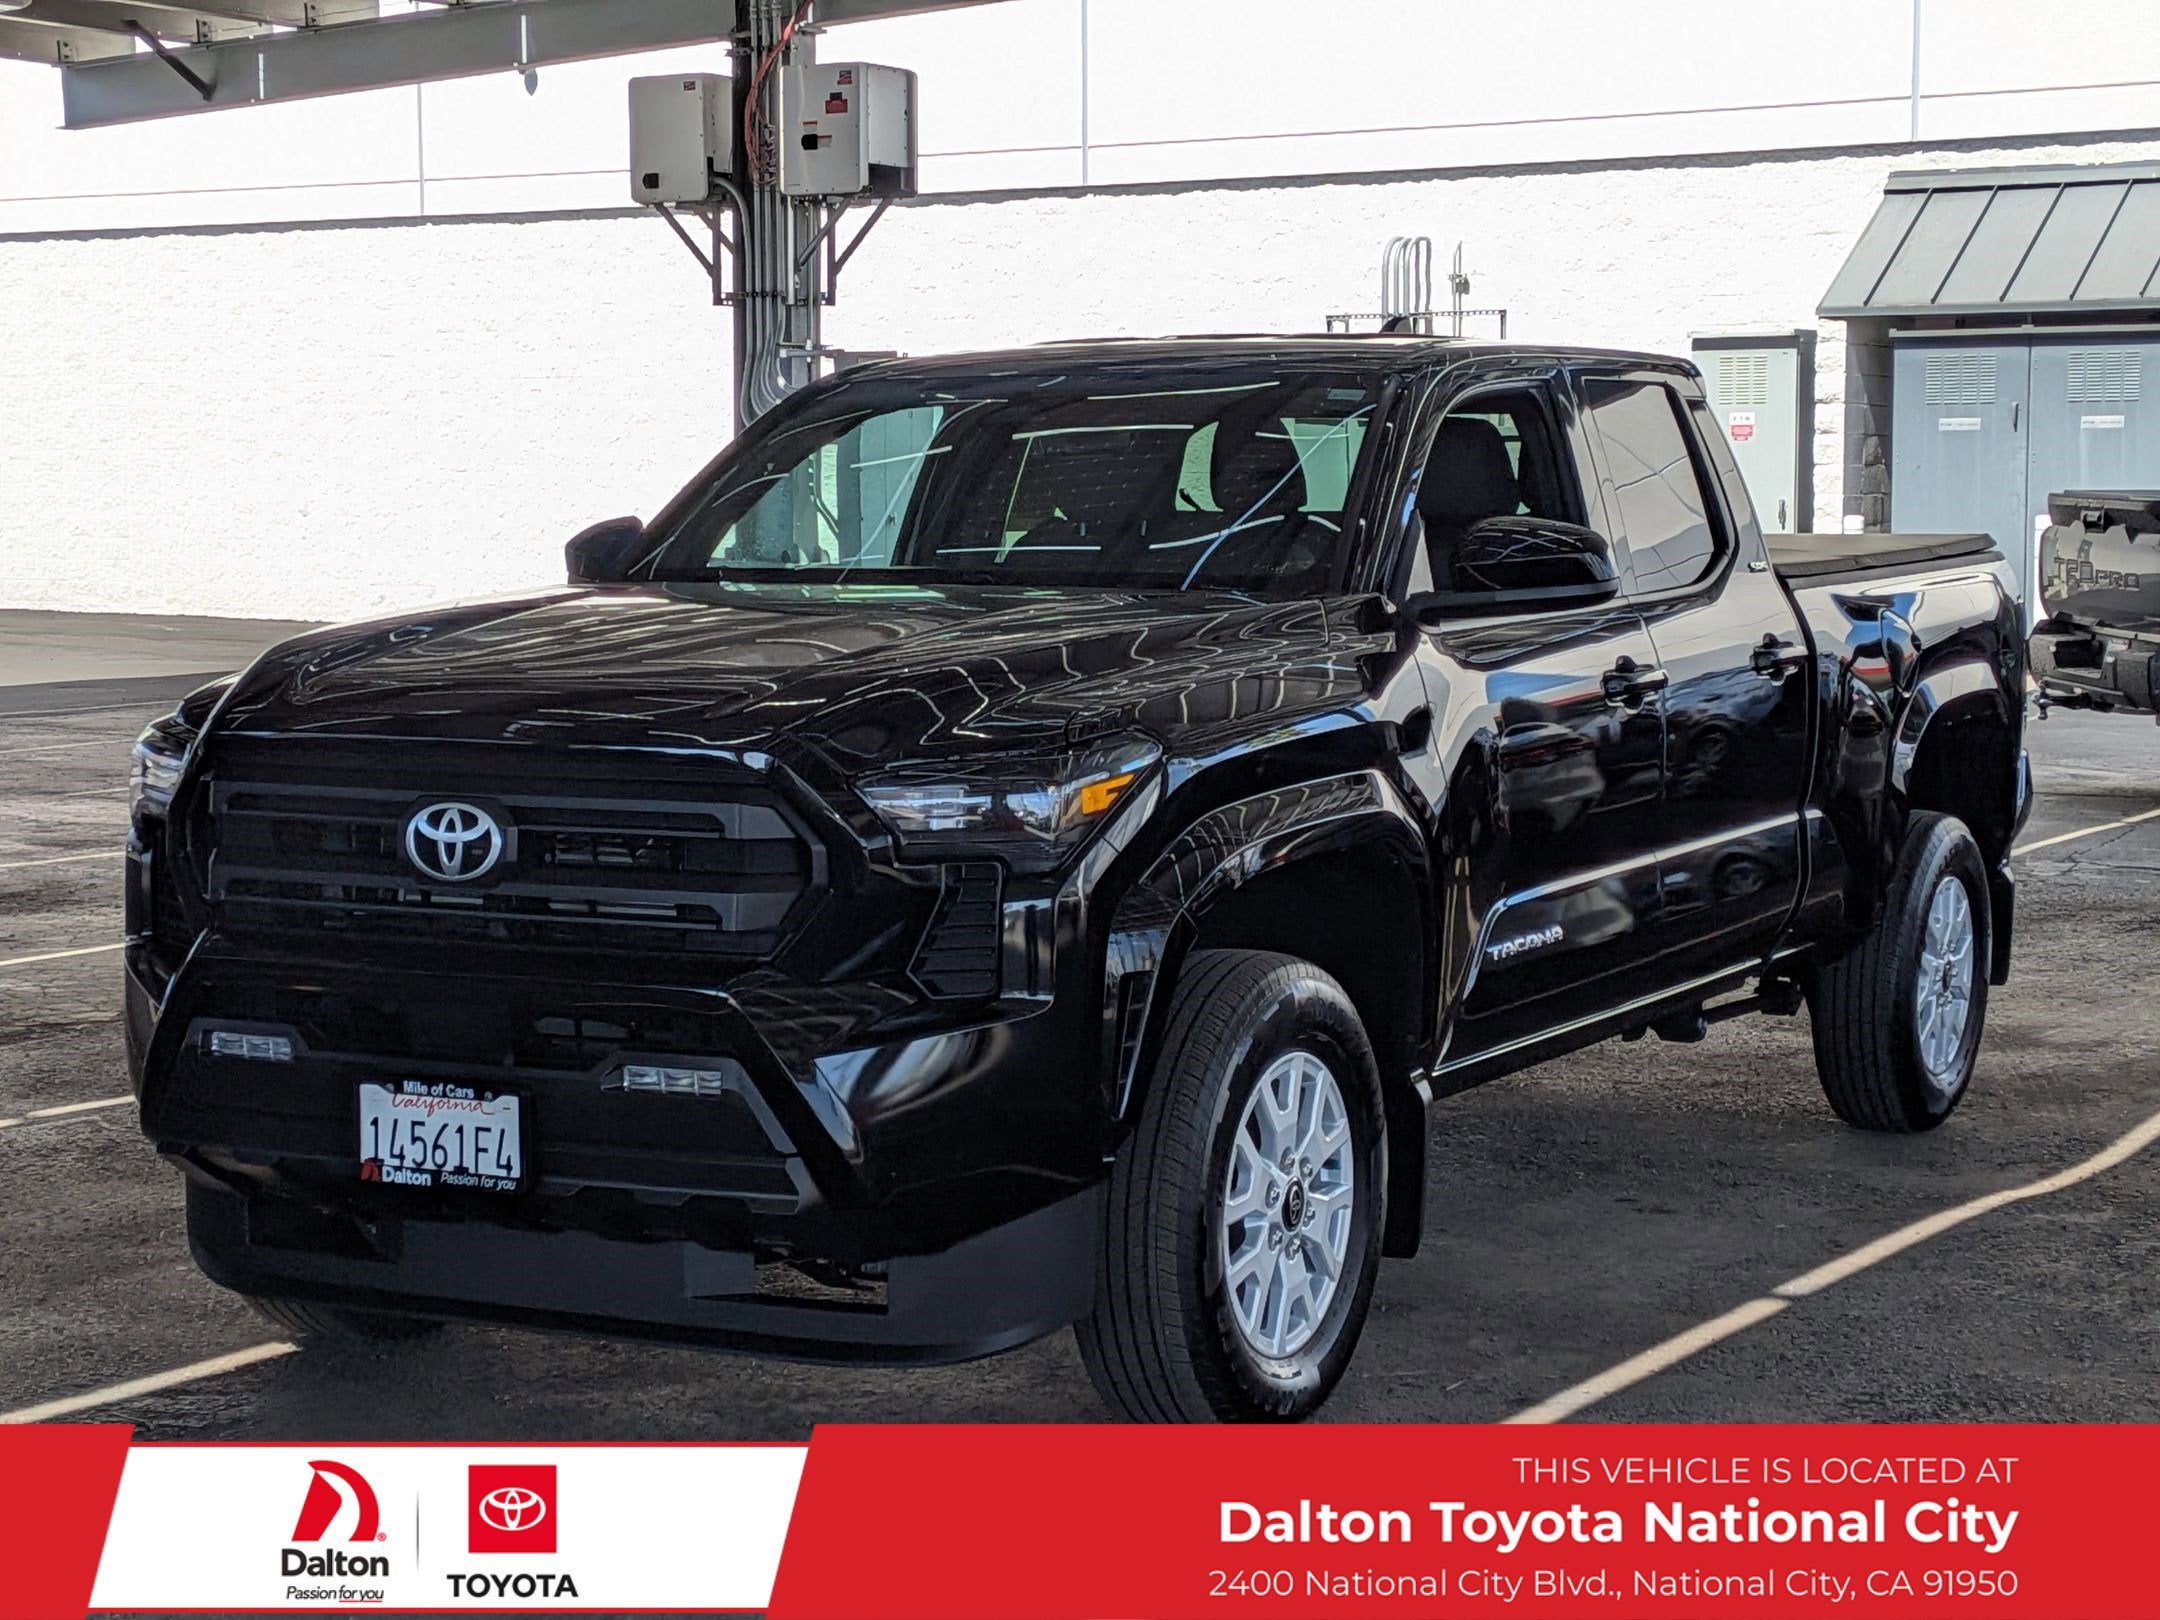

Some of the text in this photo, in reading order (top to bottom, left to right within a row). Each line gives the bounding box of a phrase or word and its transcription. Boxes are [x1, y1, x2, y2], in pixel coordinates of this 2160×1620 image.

[1486, 925, 1564, 961] TACOMA
[403, 1080, 475, 1099] Mile of Cars
[392, 1093, 495, 1117] California
[370, 1116, 514, 1176] 14561F4
[382, 1166, 517, 1191] Dalton Passion for you
